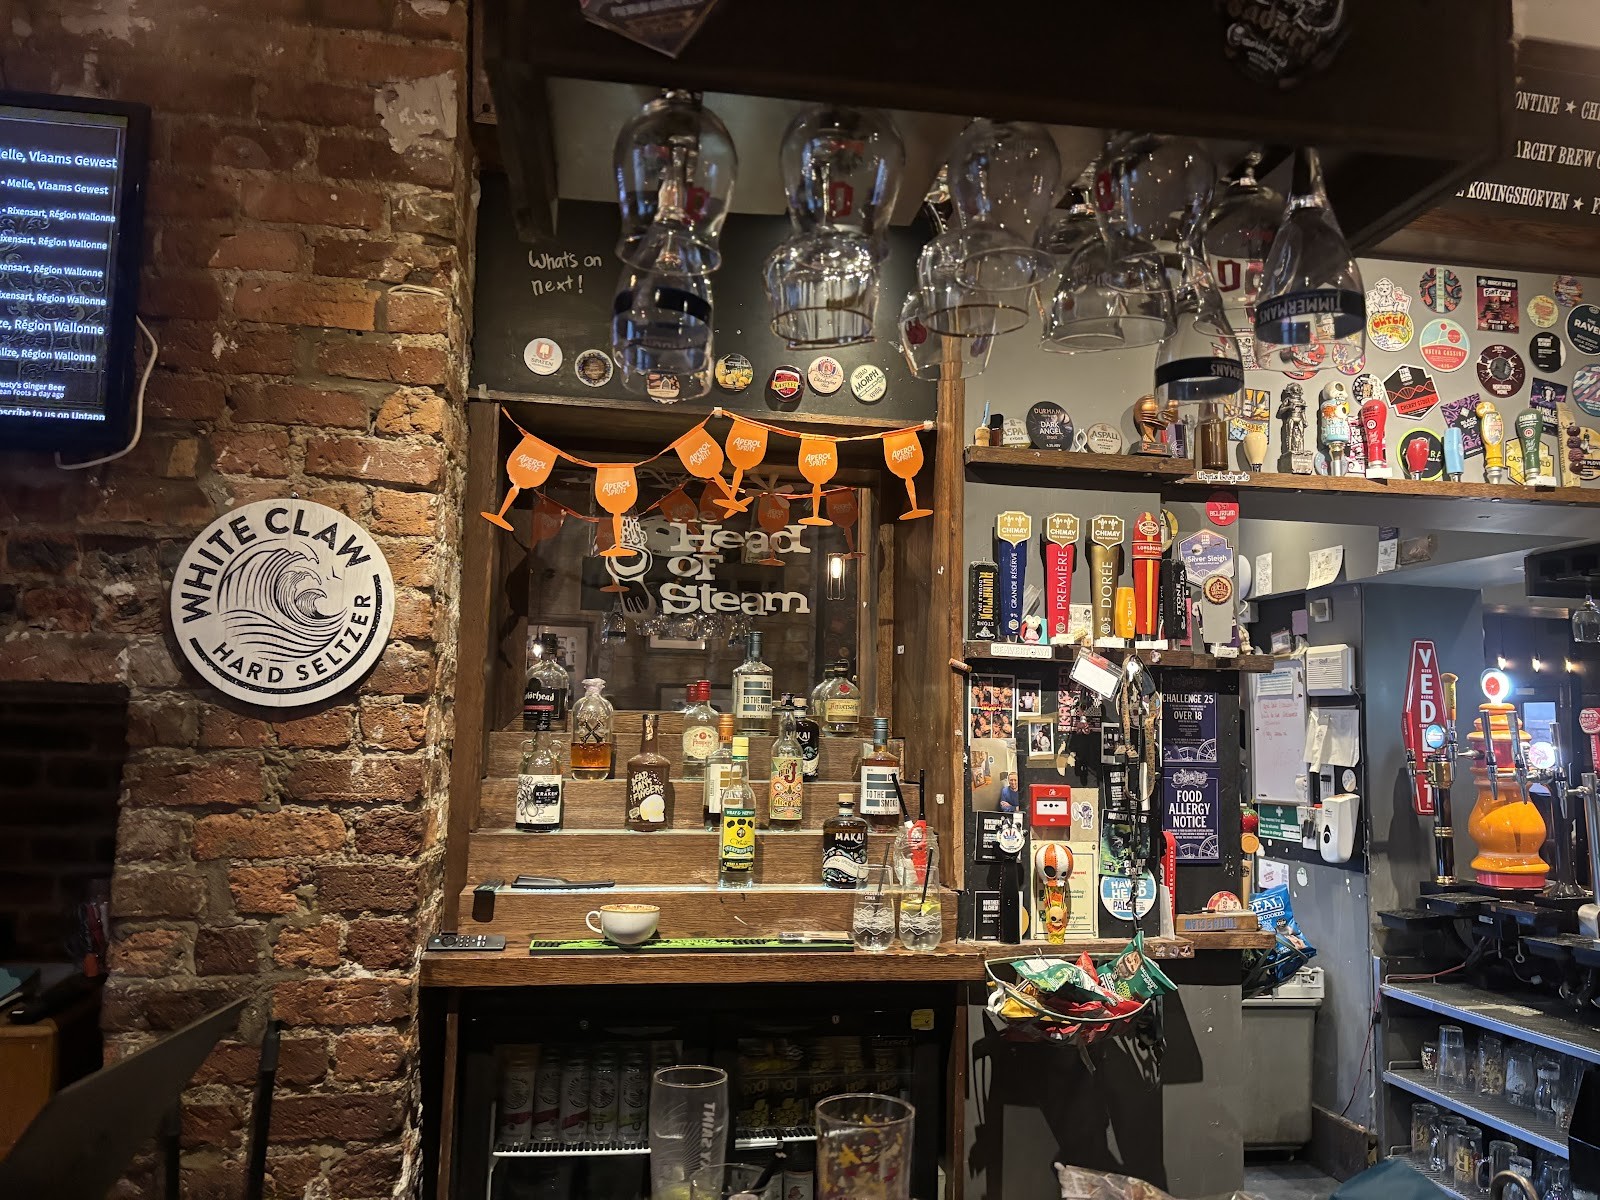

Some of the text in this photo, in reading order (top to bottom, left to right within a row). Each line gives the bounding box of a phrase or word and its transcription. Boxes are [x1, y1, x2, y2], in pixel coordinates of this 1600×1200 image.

[0, 148, 118, 168] elle, Vlaams Gewest
[1557, 146, 1596, 168] BREW
[7, 178, 109, 195] Melle, Vlaams Gewest
[1466, 180, 1570, 211] KONINGSHOEVEN
[7, 206, 116, 222] Rixensart, Région Wallonne
[0, 233, 108, 250] ixensart, Région Wallonne
[583, 253, 602, 268] on
[0, 263, 104, 277] xensart, Région Wallonne
[0, 290, 107, 306] ixensart, Région Wallonne
[14, 319, 52, 333] Région
[54, 321, 105, 335] Wallonne
[1574, 319, 1600, 336] RAVE
[0, 348, 97, 362] lize, Région Wallonne
[854, 369, 880, 393] MORPH
[0, 408, 31, 417] bscribe
[1039, 427, 1064, 436] ANGEL
[1091, 430, 1120, 441] ASPALL
[732, 436, 762, 448] APEROL
[736, 444, 756, 453] SPRITZ
[689, 441, 712, 466] APEROL
[695, 449, 712, 467] SPRITZ
[804, 452, 832, 463] APEROL
[891, 444, 917, 460] APEROL
[896, 451, 914, 464] SPRITZ
[516, 453, 547, 470] APEROL
[518, 461, 540, 474] SPRITZ
[809, 458, 828, 468] SPRITZ
[602, 479, 631, 493] APEROL
[607, 487, 627, 497] SPRITZ
[265, 507, 372, 568] CLAW
[669, 522, 811, 554] Head
[1050, 528, 1077, 536] CHIMAY
[1095, 529, 1121, 537] CHIMAY
[1187, 555, 1206, 564] Silver
[1207, 555, 1228, 565] Sleigh
[181, 515, 257, 625] WHITE
[1056, 550, 1068, 610] PREMIÈRE
[1100, 561, 1113, 609] DORÉE
[659, 582, 811, 616] Steam
[980, 571, 994, 621] RUINATION
[295, 594, 372, 682] SELTZER
[212, 641, 284, 684] HARD
[743, 696, 761, 704] TO THE
[1161, 693, 1214, 704] CHALLENGE 25
[1173, 711, 1203, 721] OVER 18
[1418, 648, 1437, 804] VEDET
[633, 784, 664, 802] FINGERS
[866, 790, 885, 799] TO THE
[1176, 790, 1203, 803] FOOD
[1168, 802, 1211, 816] ALLERGY
[1172, 815, 1207, 829] NOTICE
[834, 832, 865, 843] MAKAI
[1111, 878, 1147, 889] HAWS
[1111, 888, 1147, 900] HED
[1113, 900, 1132, 911] PALE
